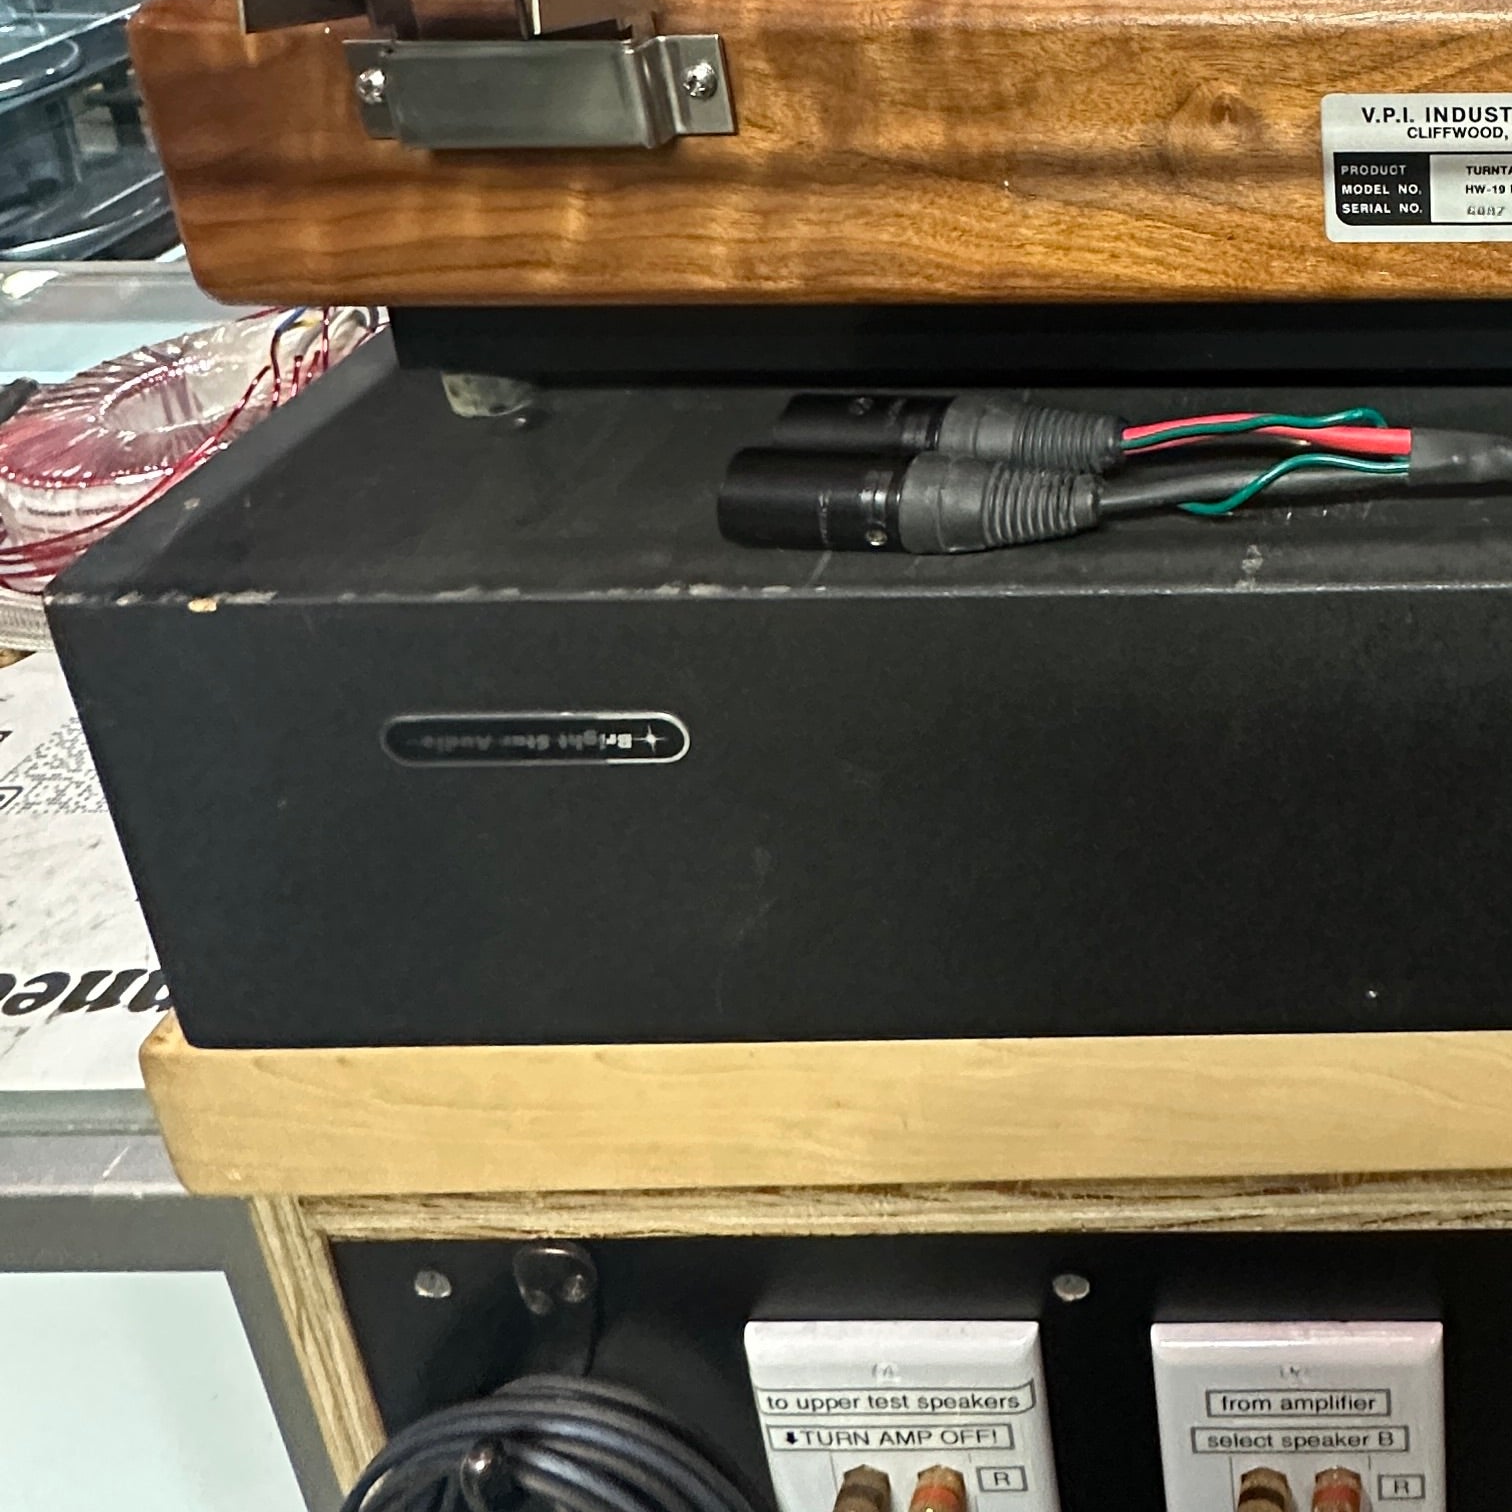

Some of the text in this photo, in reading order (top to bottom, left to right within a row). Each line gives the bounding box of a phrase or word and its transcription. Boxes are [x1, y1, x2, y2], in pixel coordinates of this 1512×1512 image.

[1361, 106, 1415, 124] V.P.I.
[1406, 126, 1510, 141] CLIFFWOOD,
[1340, 164, 1408, 177] PRODUCT
[1341, 184, 1423, 196] MODEL NO.
[1465, 184, 1506, 195] HW-19
[1341, 203, 1423, 215] SERIAL NO.
[767, 1392, 1021, 1413] to upper test speakers
[1221, 1393, 1377, 1415] from amplifier
[802, 1428, 998, 1447] TURN AMP OFF!
[1207, 1431, 1395, 1452] select speaker B
[993, 1471, 1011, 1487] R
